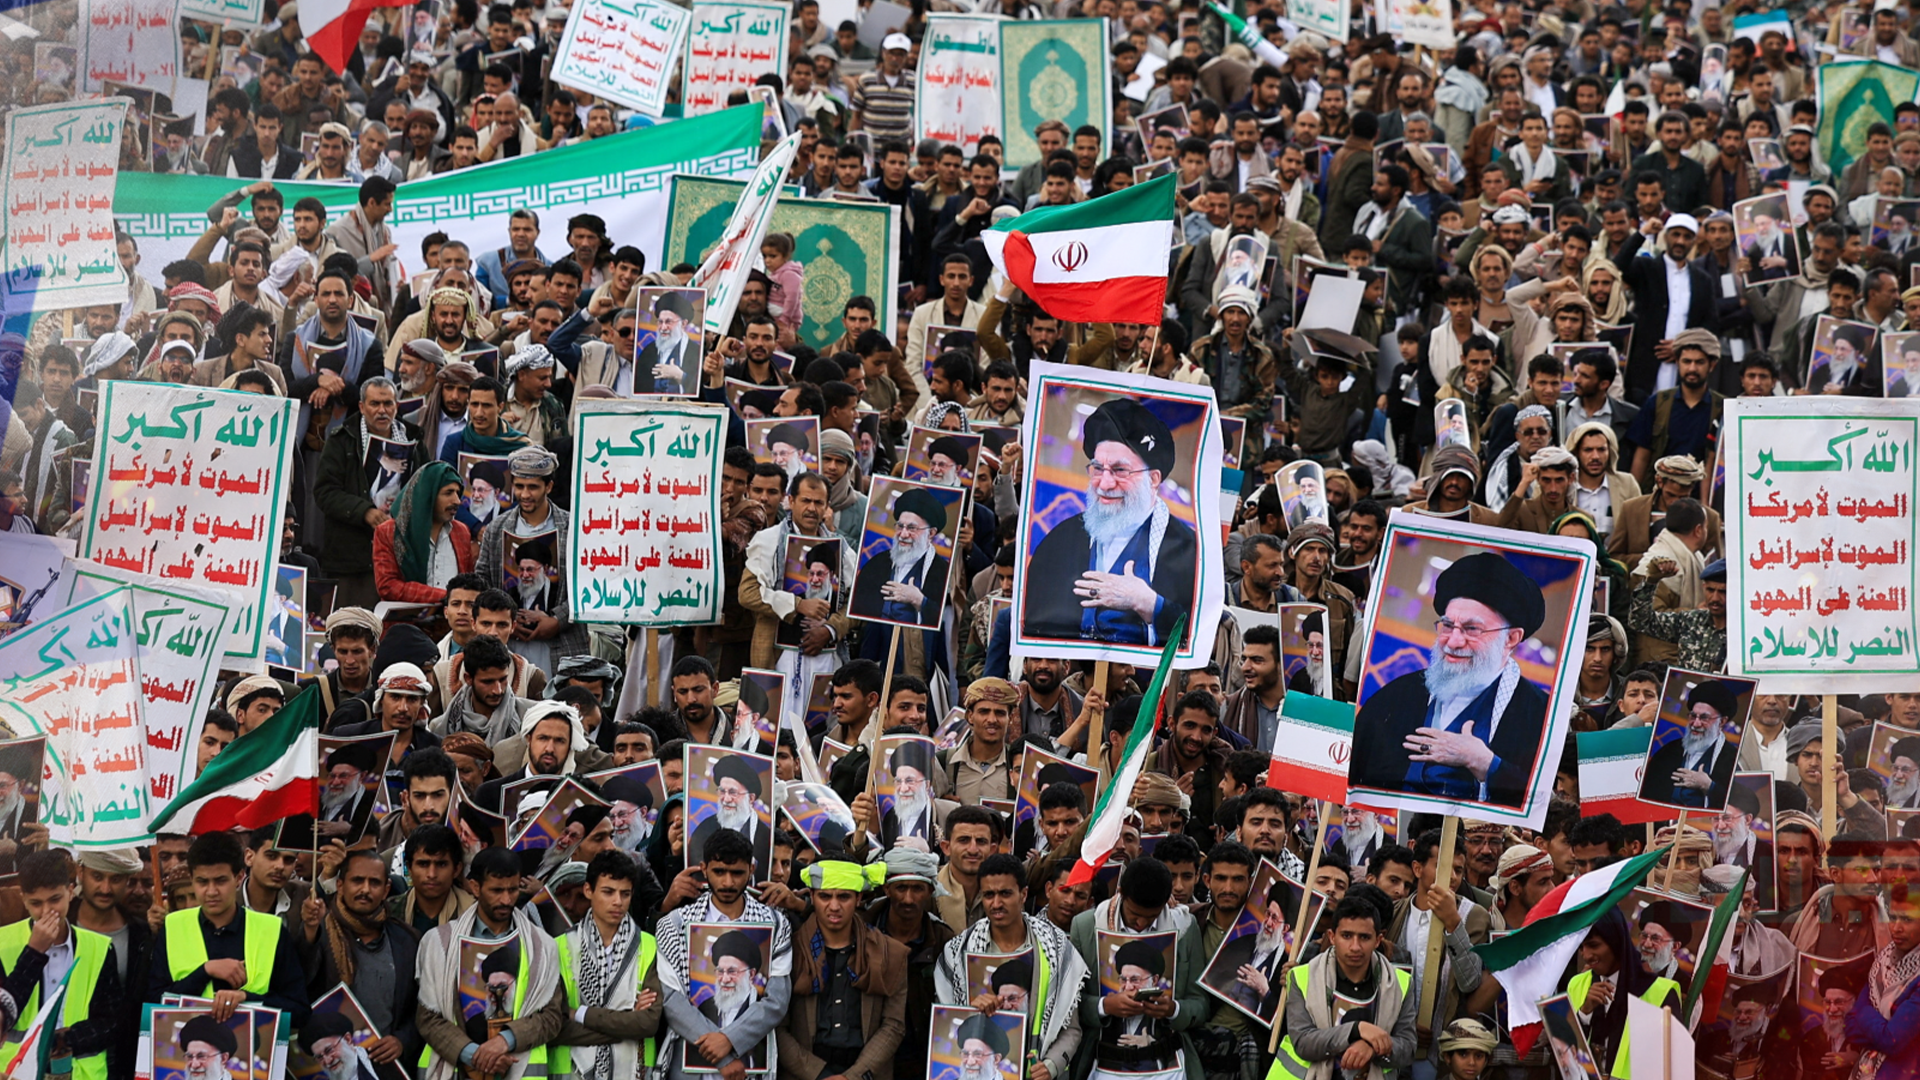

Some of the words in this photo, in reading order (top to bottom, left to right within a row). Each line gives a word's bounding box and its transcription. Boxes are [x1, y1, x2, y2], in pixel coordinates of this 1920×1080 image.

[650, 9, 680, 35] الله
[693, 9, 746, 39] أكبر
[747, 13, 780, 36] الله
[128, 32, 134, 53] و
[630, 27, 669, 54] الموت
[740, 46, 776, 63] الموت
[624, 47, 662, 73] الموت
[111, 393, 215, 451] أكبر
[215, 404, 279, 447] الله
[585, 418, 664, 467] أكبر
[667, 424, 711, 459] الله
[1747, 421, 1869, 487] أكبر
[1862, 429, 1909, 473] الله
[108, 452, 193, 488] لأمريكا
[199, 465, 270, 497] الموت
[584, 466, 652, 499] لأمريكا
[657, 474, 707, 501] الموت
[99, 497, 187, 541] لإسرائيل
[1748, 485, 1829, 523] لأمريكا
[1837, 492, 1907, 523] الموت
[193, 512, 265, 543] الموت
[582, 506, 650, 537] لإسرائيل
[656, 511, 708, 538] الموت
[159, 551, 194, 579] على
[580, 544, 629, 572] اليهود
[635, 546, 661, 572] على
[668, 546, 711, 570] اللعنة
[1749, 536, 1834, 570] لإسرائيل
[1838, 539, 1907, 570] الموت
[204, 551, 259, 587] اللعنة
[581, 577, 646, 619] للإسلام
[651, 576, 709, 616] النصر
[1750, 585, 1812, 616] اليهود
[1817, 586, 1851, 616] على
[1857, 585, 1907, 611] اللعنة
[86, 603, 131, 649] الله
[136, 598, 185, 648] أك
[165, 612, 214, 659] الله
[1749, 626, 1840, 667] للإسلام
[1843, 626, 1911, 664] النصر
[142, 673, 195, 705] الموت
[145, 726, 183, 752] الم
[93, 743, 144, 774] اللعنة
[90, 783, 149, 833] النصر
